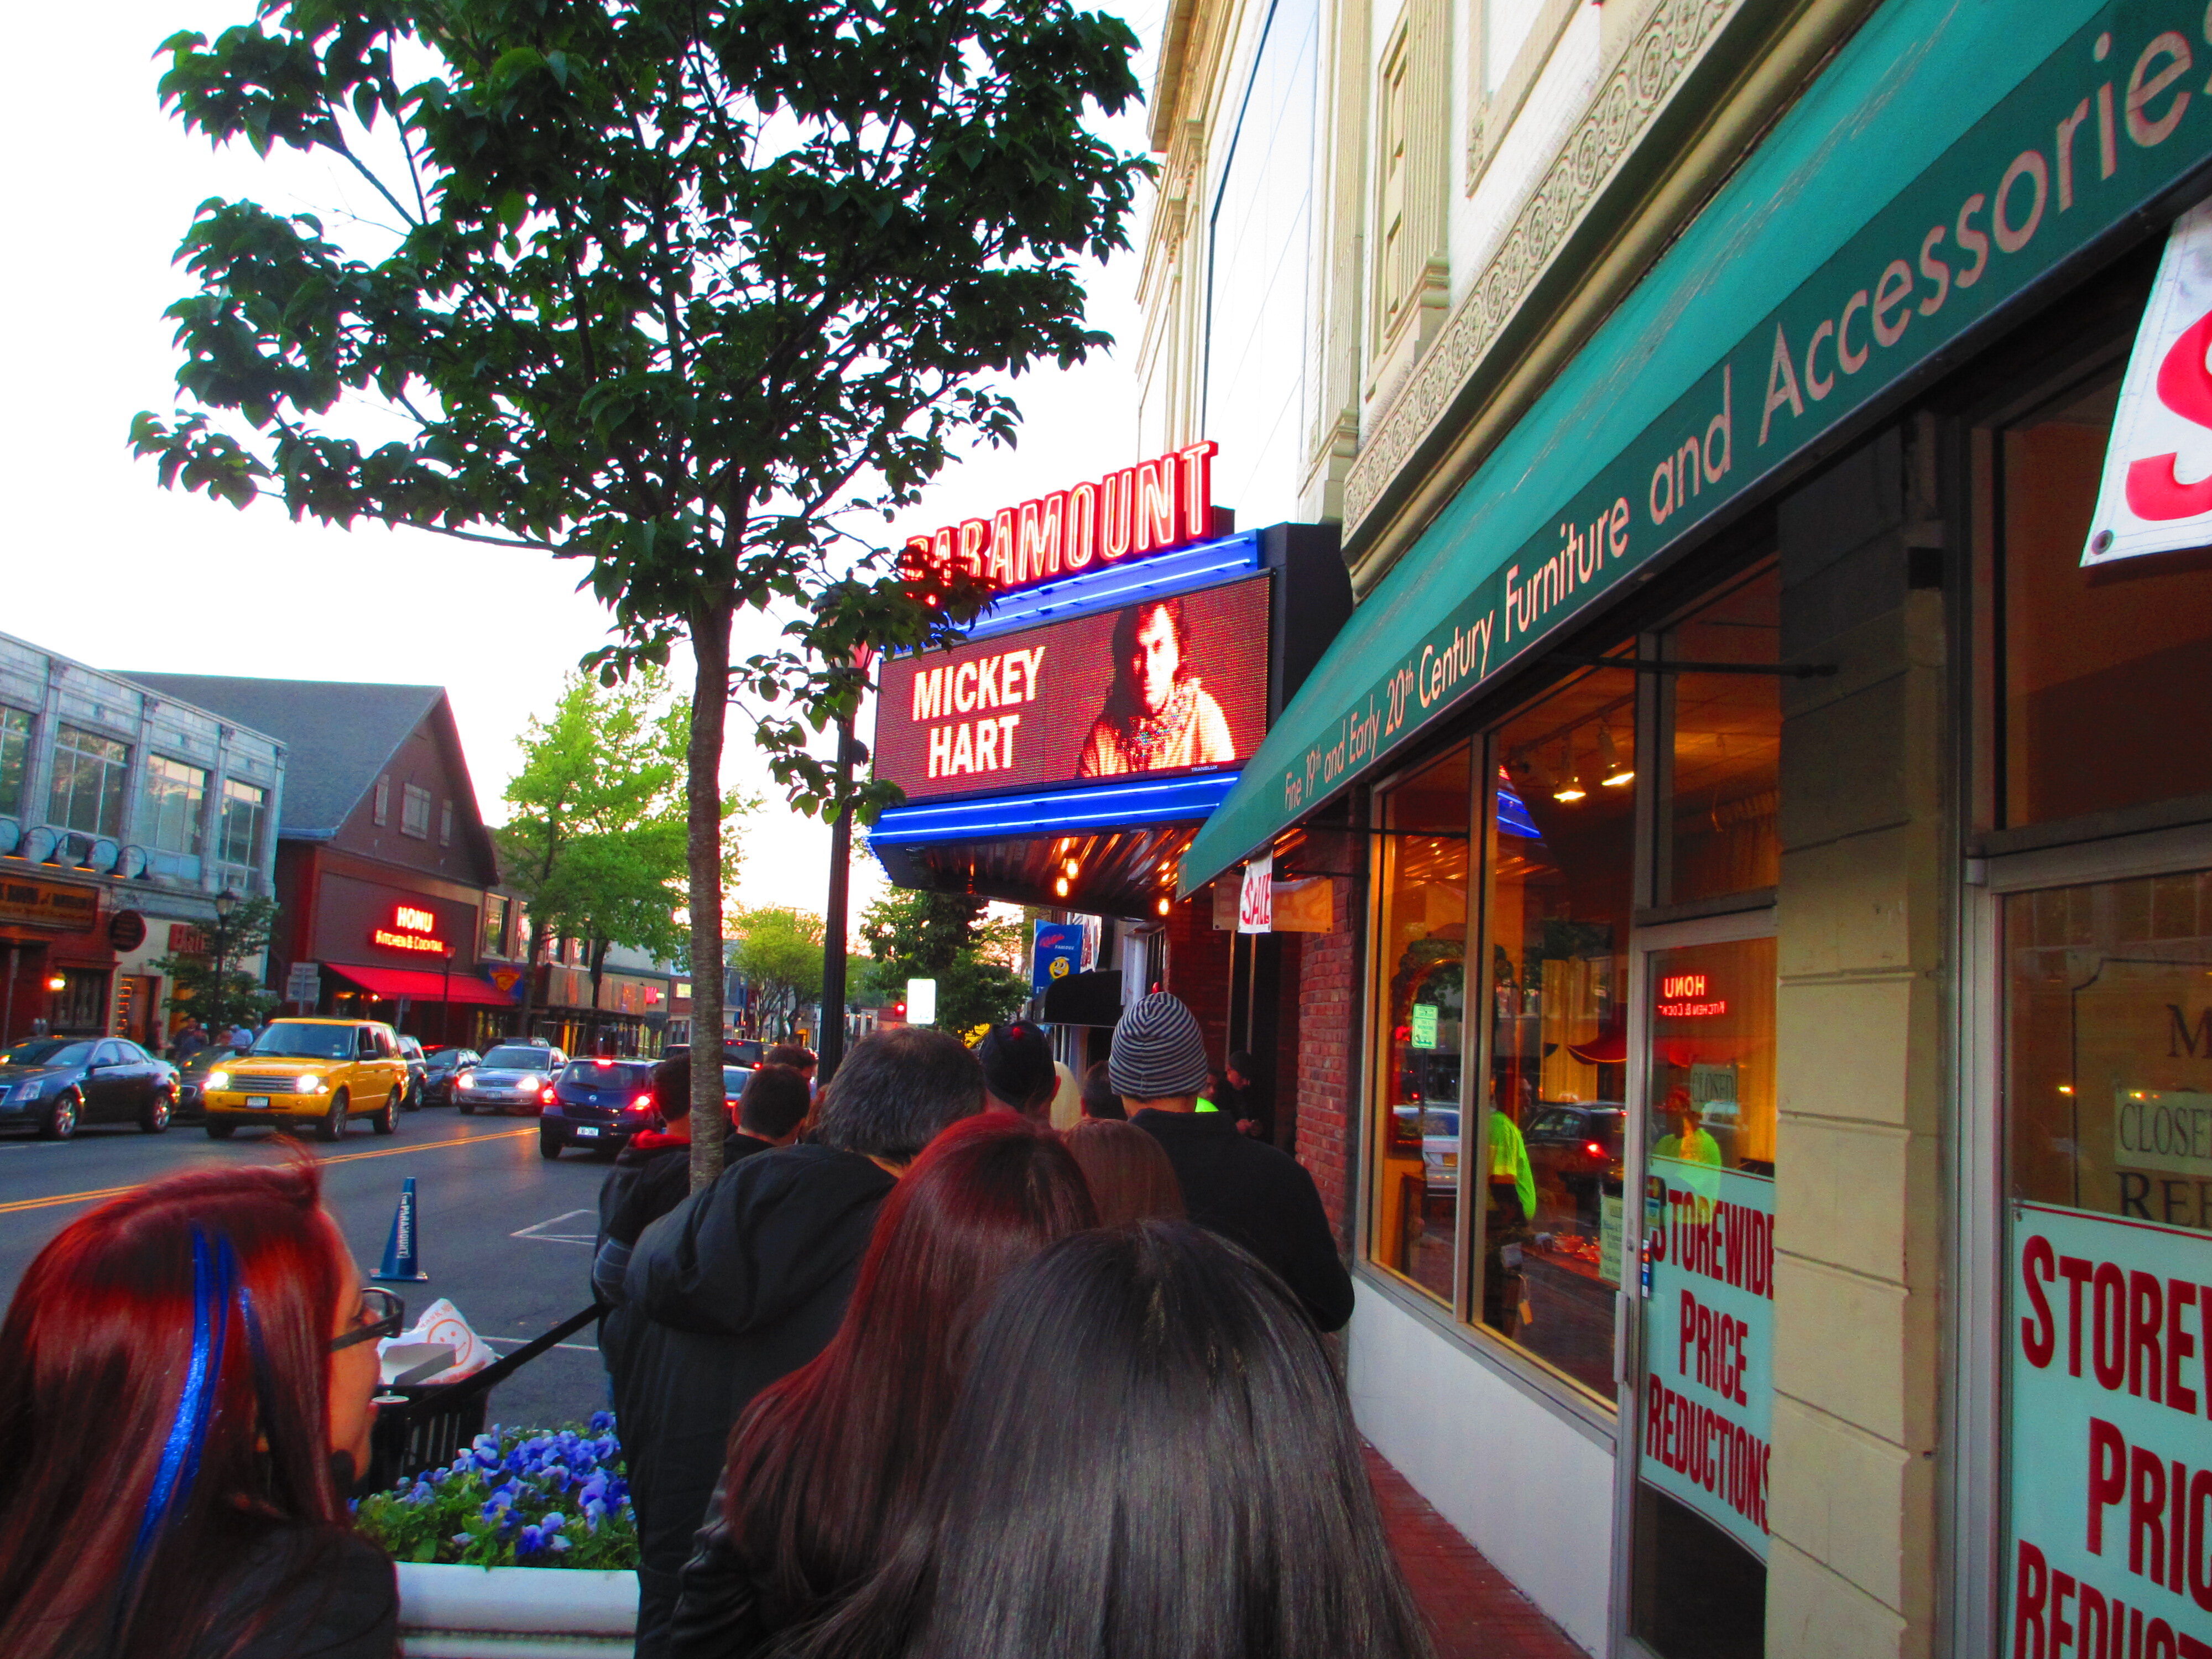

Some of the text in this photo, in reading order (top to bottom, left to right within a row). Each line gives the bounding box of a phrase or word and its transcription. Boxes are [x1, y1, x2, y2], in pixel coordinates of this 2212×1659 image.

[1285, 771, 1302, 811] Fine
[1306, 744, 1321, 798] 19th
[1324, 719, 1346, 783] and
[1349, 694, 1381, 763] Early
[1385, 660, 1415, 737] 20th
[1418, 609, 1494, 708] Century
[1504, 496, 1630, 643] Furniture
[1649, 364, 1731, 525] and
[912, 645, 1046, 721] MICKEY
[928, 714, 1020, 778] HART
[397, 906, 433, 932] HONU
[1241, 873, 1271, 925] SALE
[375, 929, 406, 947] KITCHEN
[2119, 1103, 2212, 1159] CLOSE
[399, 1204, 410, 1255] PARAMOUNT
[1679, 1288, 1748, 1408] PRICE
[1646, 1372, 1771, 1536] REDUCTIONS
